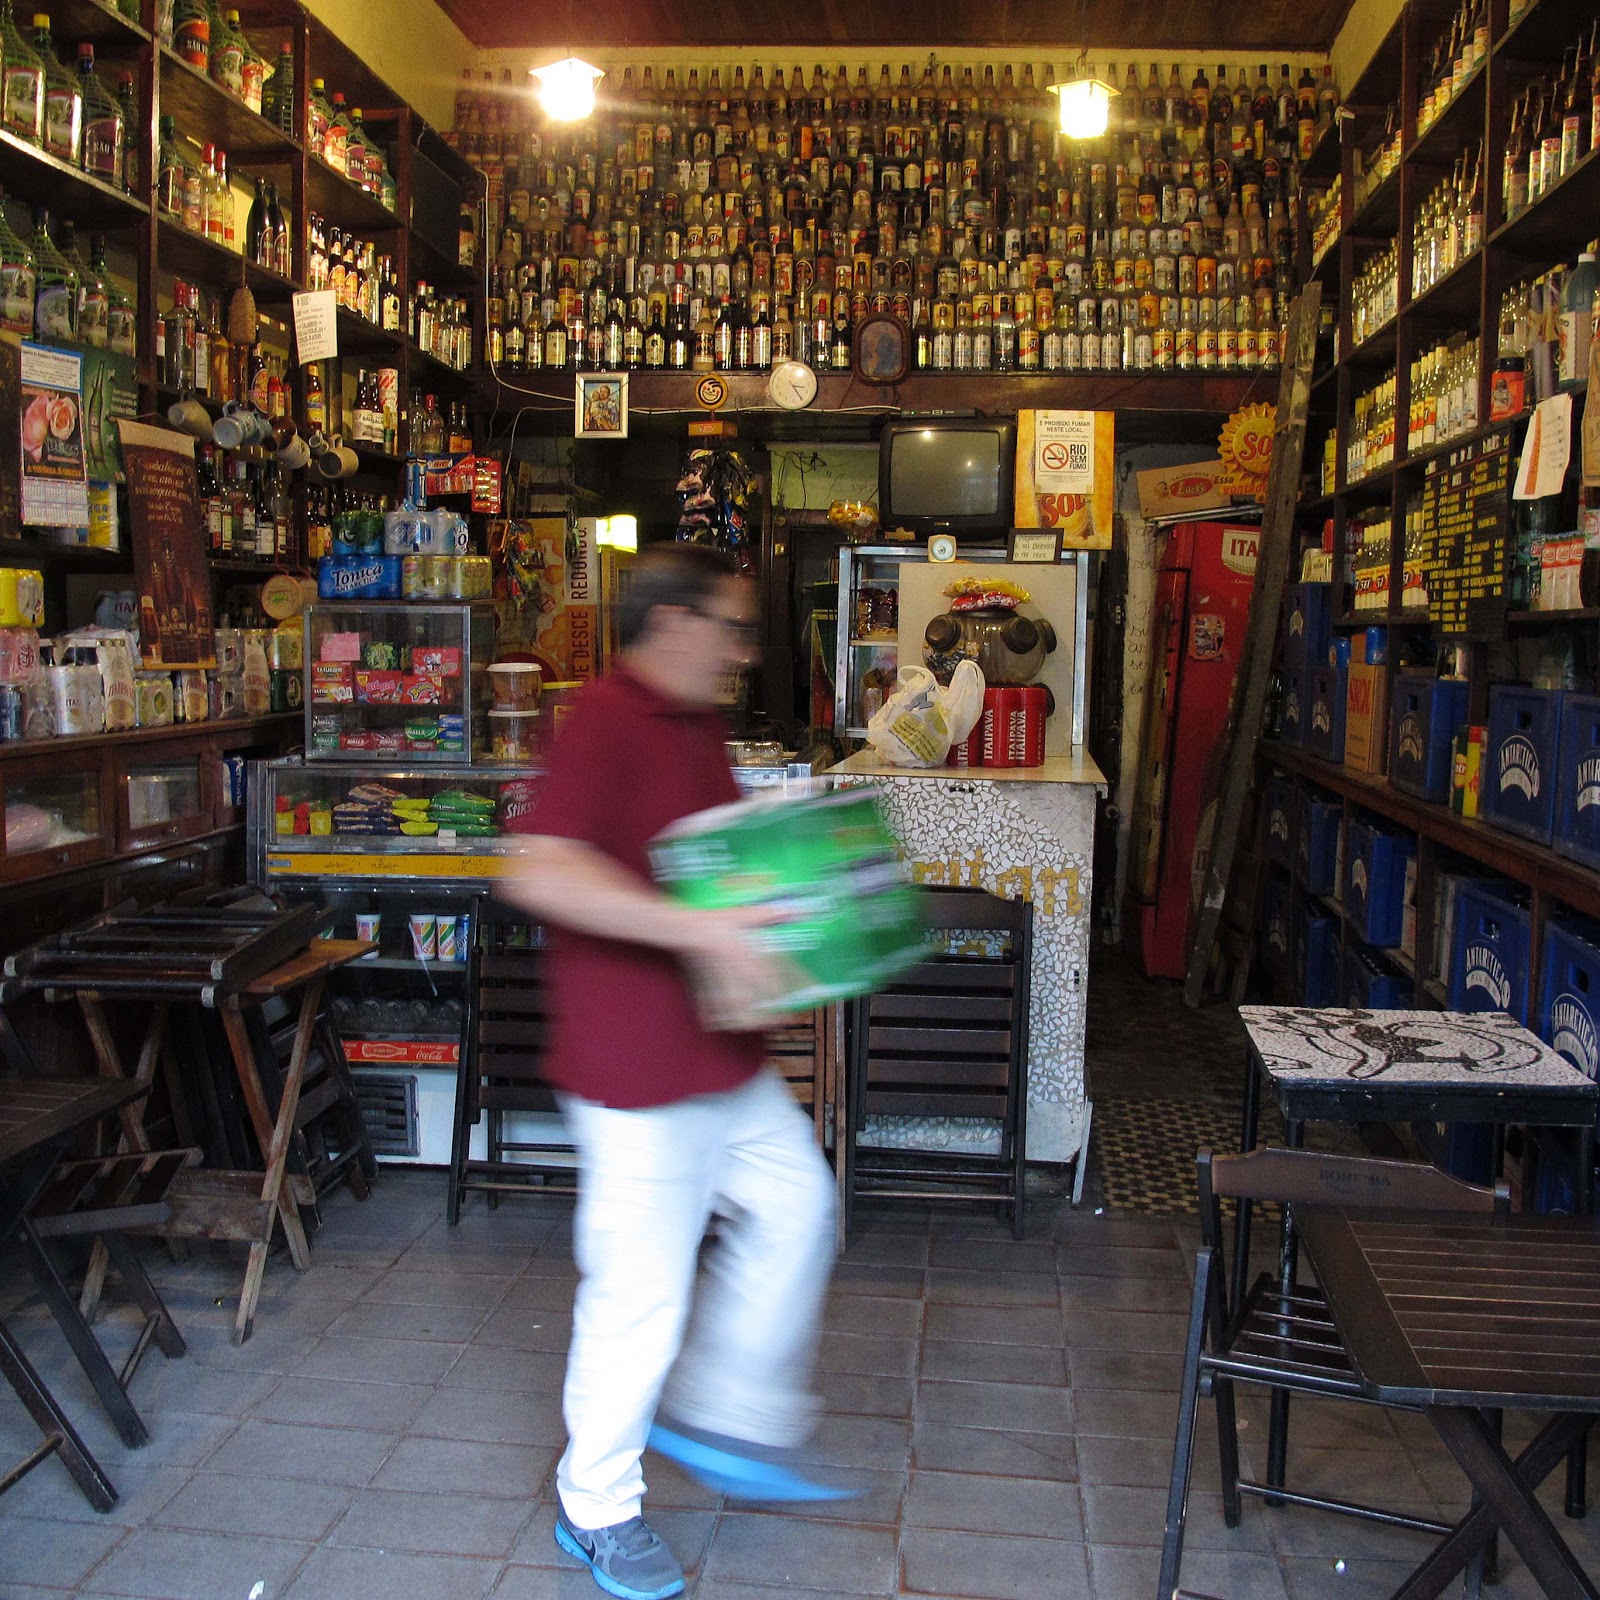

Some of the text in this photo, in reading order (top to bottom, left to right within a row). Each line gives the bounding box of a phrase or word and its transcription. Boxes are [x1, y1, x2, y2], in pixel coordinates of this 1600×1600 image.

[1070, 444, 1087, 456] RIO
[1070, 455, 1087, 464] SEM
[1239, 431, 1273, 461] SO
[1230, 538, 1258, 558] ITA
[571, 611, 589, 659] DESCE
[983, 709, 994, 760] ITAIPAVA
[1008, 710, 1018, 760] ITAIPAVA
[1016, 710, 1027, 760] ITAIPAVA
[957, 740, 968, 760] ITA
